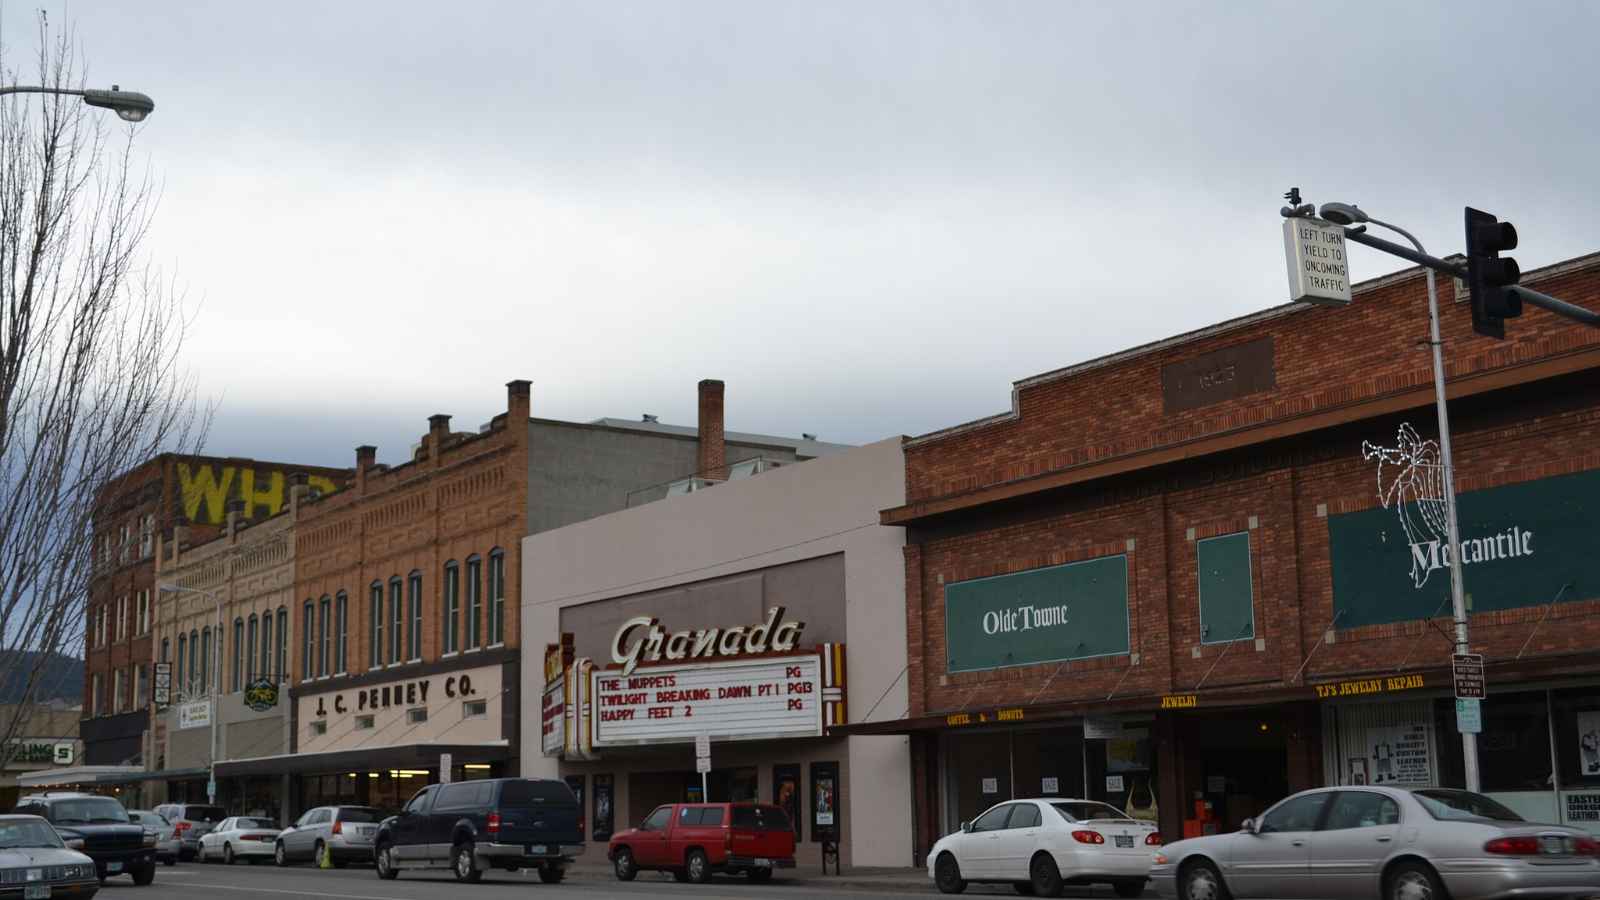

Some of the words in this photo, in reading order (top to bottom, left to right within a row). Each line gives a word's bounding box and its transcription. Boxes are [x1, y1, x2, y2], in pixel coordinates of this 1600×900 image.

[1300, 228, 1318, 241] LEFT
[1322, 231, 1342, 245] TURN
[1304, 243, 1328, 258] YIELD
[1332, 249, 1341, 260] TO
[1305, 259, 1345, 277] ONCOMING
[1309, 275, 1344, 292] TRAFFIC
[1410, 525, 1534, 570] Mecantile
[982, 608, 1018, 635] Olde
[1018, 604, 1069, 631] Towne
[611, 606, 804, 677] Granada
[600, 679, 620, 691] THE
[628, 676, 676, 689] MUPPETS
[786, 666, 801, 679] PG
[1340, 680, 1382, 696] JEWELRY
[1387, 675, 1424, 690] REPAIR
[335, 694, 347, 714] C.
[358, 680, 430, 711] PENNEY
[445, 674, 476, 698] CO.
[600, 693, 648, 706] TWILIGHT
[656, 688, 710, 703] BREAKING
[718, 685, 752, 699] DAWN
[758, 684, 772, 697] PT
[787, 682, 813, 695] PG13
[1161, 695, 1197, 709] JEWELRY
[600, 709, 635, 722] HAPPY
[647, 706, 674, 719] FEET
[684, 705, 693, 717] 2
[787, 699, 803, 711] PG
